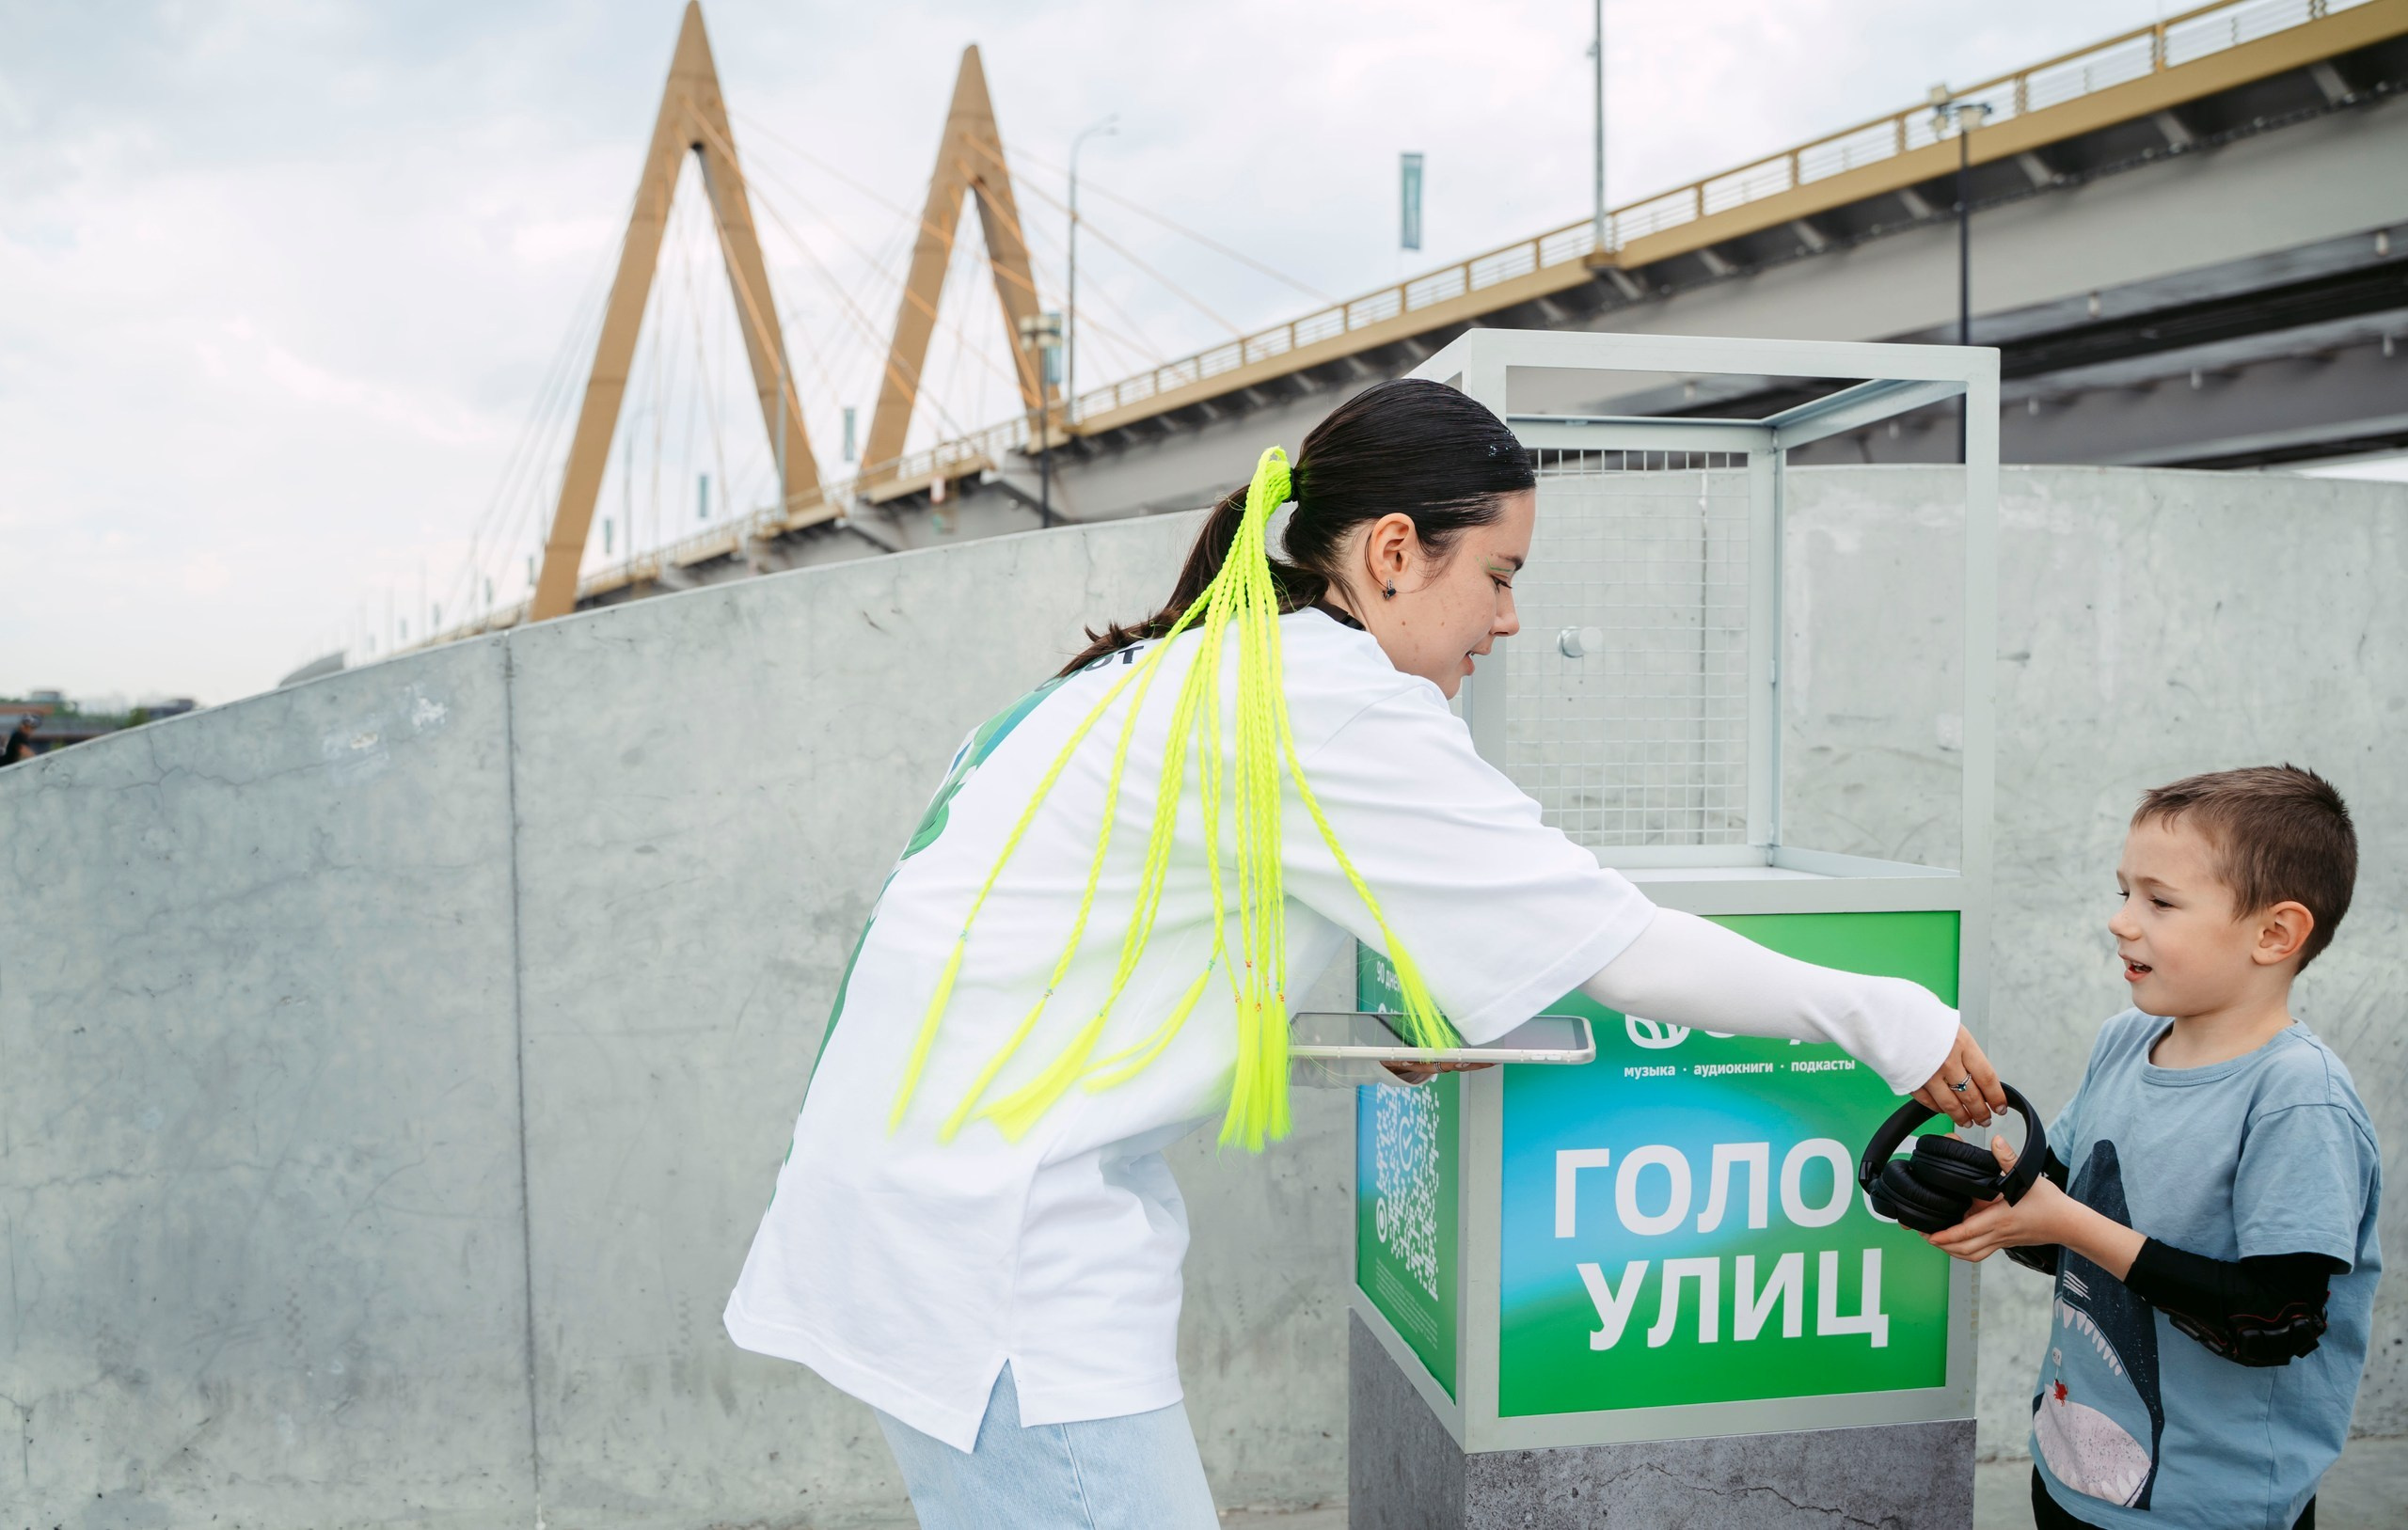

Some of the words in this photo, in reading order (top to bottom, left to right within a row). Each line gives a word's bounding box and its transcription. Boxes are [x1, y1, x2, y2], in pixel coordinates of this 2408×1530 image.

[1376, 960, 1386, 985] 90
[1624, 1065, 1676, 1080] музыка
[1693, 1061, 1774, 1077] аудиокниги
[1790, 1059, 1856, 1074] подкасты
[1576, 1248, 1890, 1351] УЛИЦ
